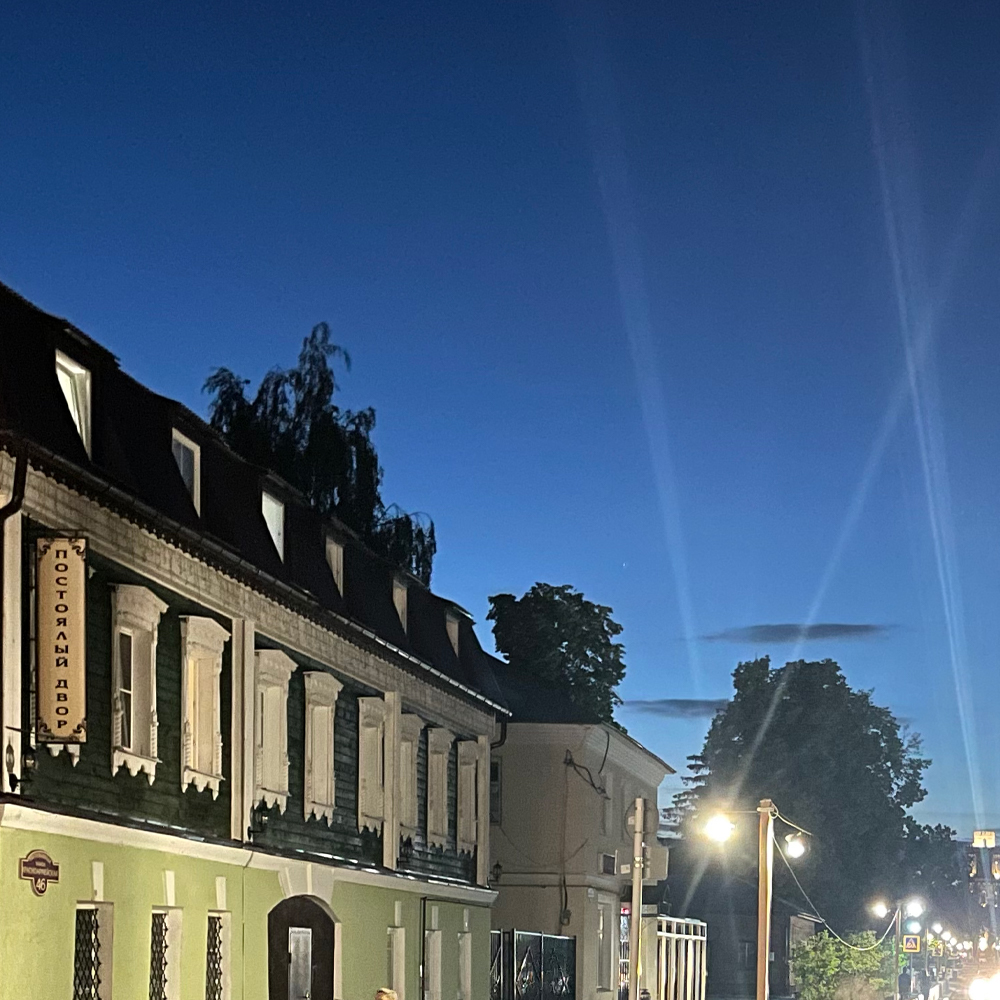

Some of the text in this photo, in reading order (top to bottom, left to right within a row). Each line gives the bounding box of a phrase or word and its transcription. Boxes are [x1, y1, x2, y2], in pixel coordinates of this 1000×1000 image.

[54, 549, 69, 729] ПОСТОЯЛЫЙ ДВОР
[36, 878, 46, 891] 46
